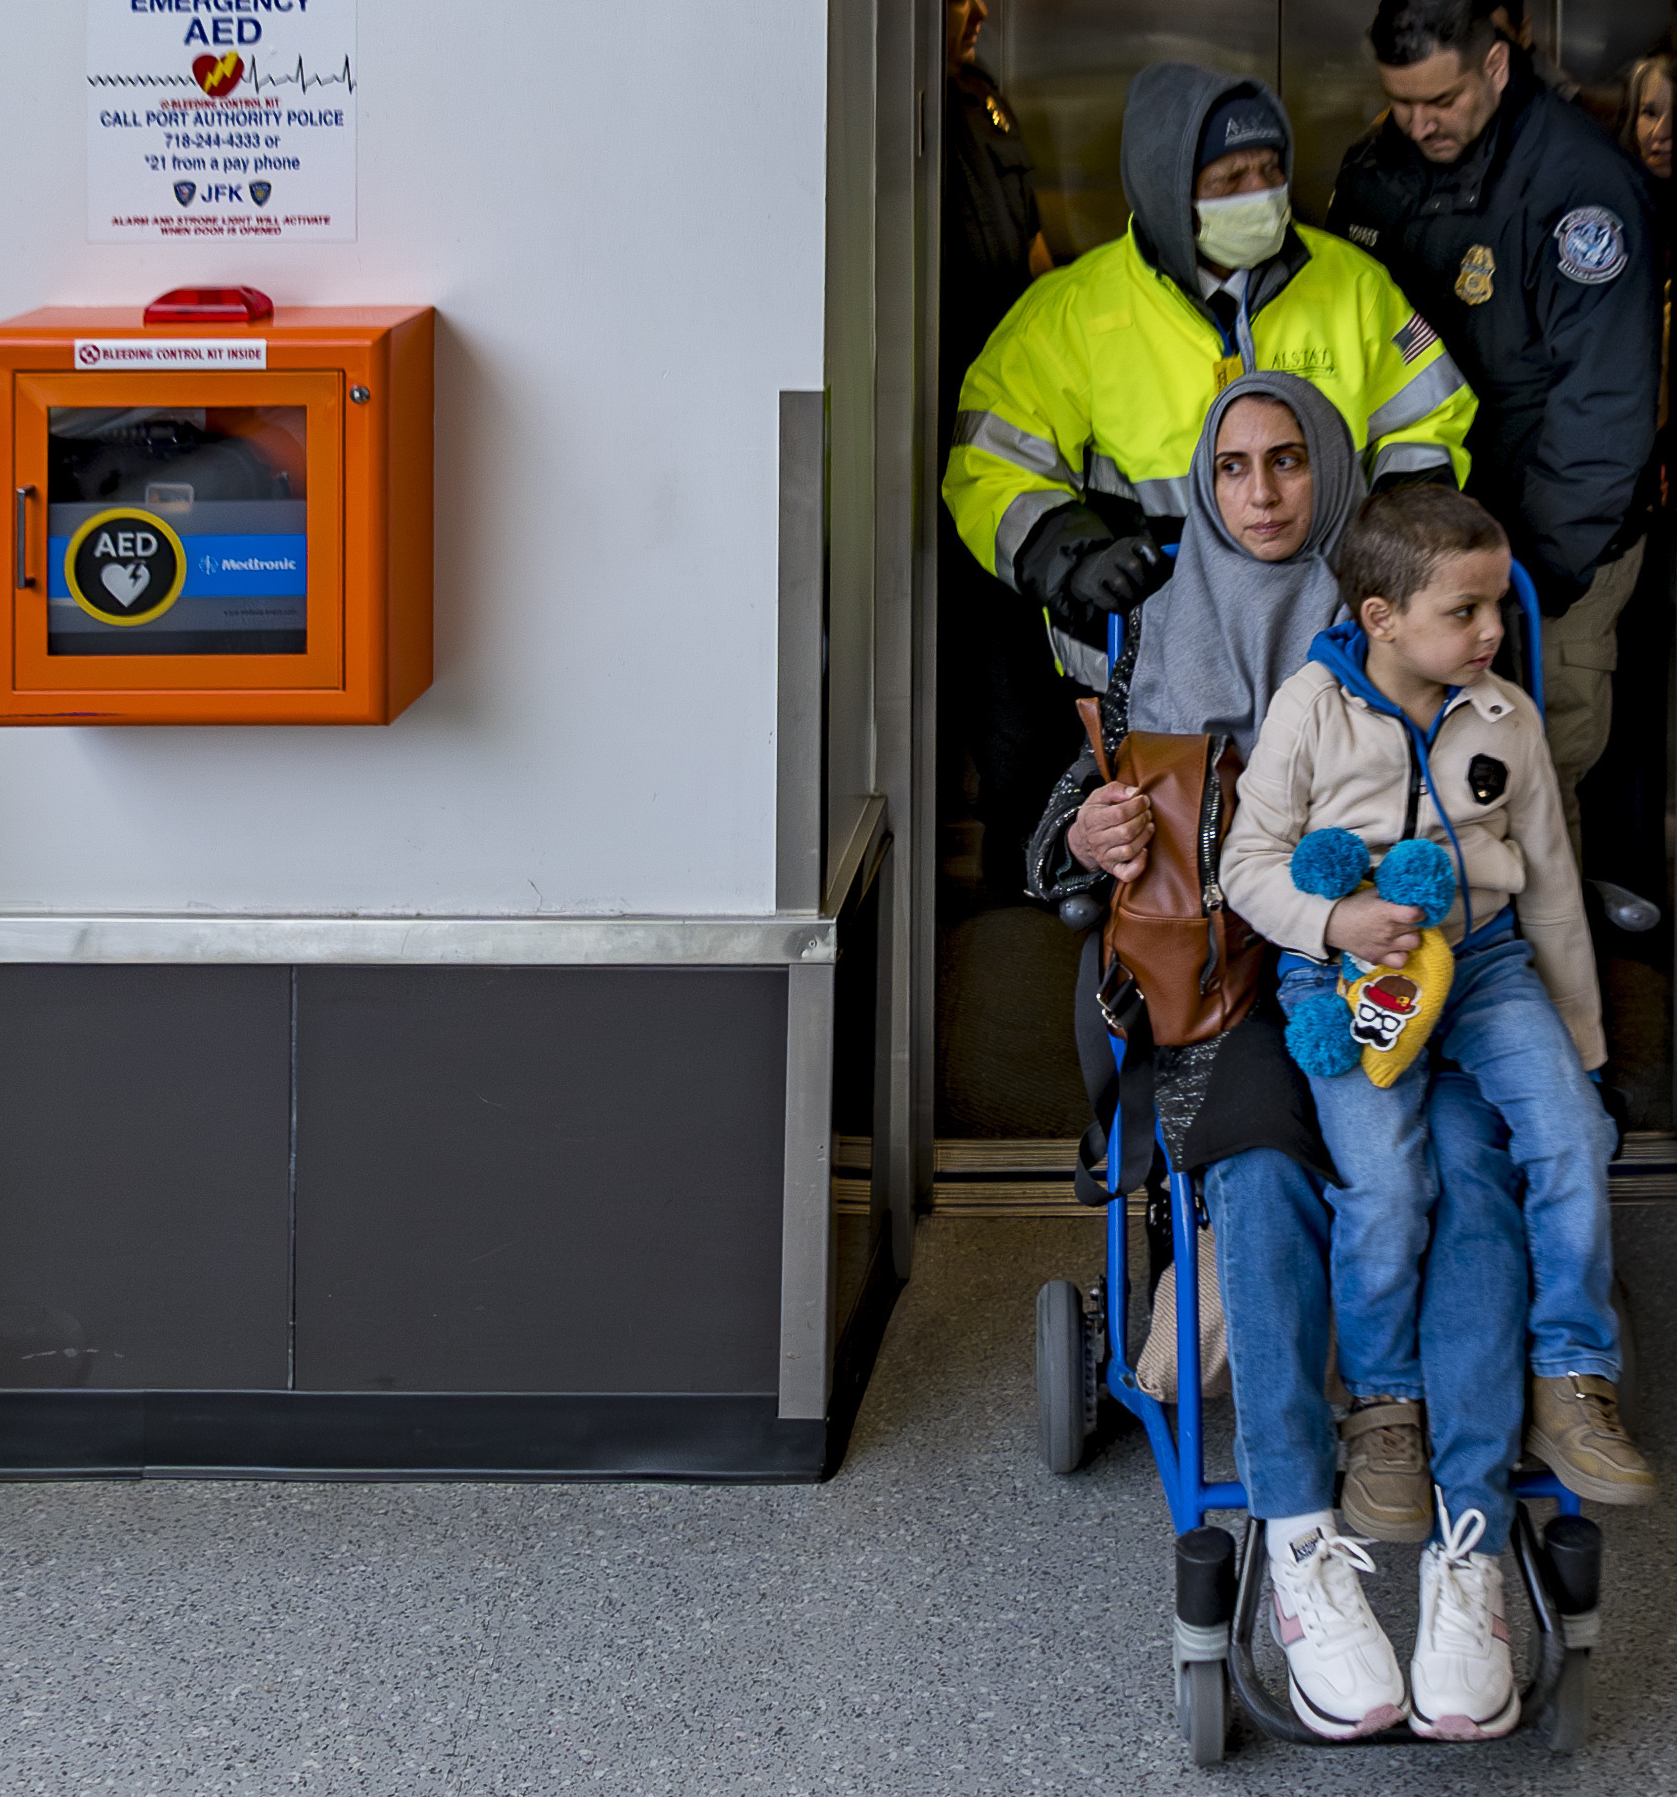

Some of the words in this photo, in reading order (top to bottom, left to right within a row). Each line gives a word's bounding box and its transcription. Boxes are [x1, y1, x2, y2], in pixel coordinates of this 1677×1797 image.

[184, 18, 262, 45] AED
[220, 98, 262, 109] CONTROL
[265, 98, 280, 109] KIT
[100, 111, 141, 128] CALL
[147, 111, 189, 127] PORT
[193, 110, 282, 127] AUTHORITY
[287, 110, 344, 127] POLICE
[264, 136, 281, 149] or
[172, 156, 206, 170] from
[210, 159, 219, 170] a
[223, 159, 249, 175] pay
[254, 155, 300, 175] phone
[201, 184, 243, 203] JFK
[102, 347, 153, 361] BLEEDING
[156, 347, 205, 361] CONTROL
[208, 347, 225, 361] KIT
[227, 347, 262, 361] INSIDE
[94, 531, 159, 559] AED
[221, 556, 297, 573] Medtronic
